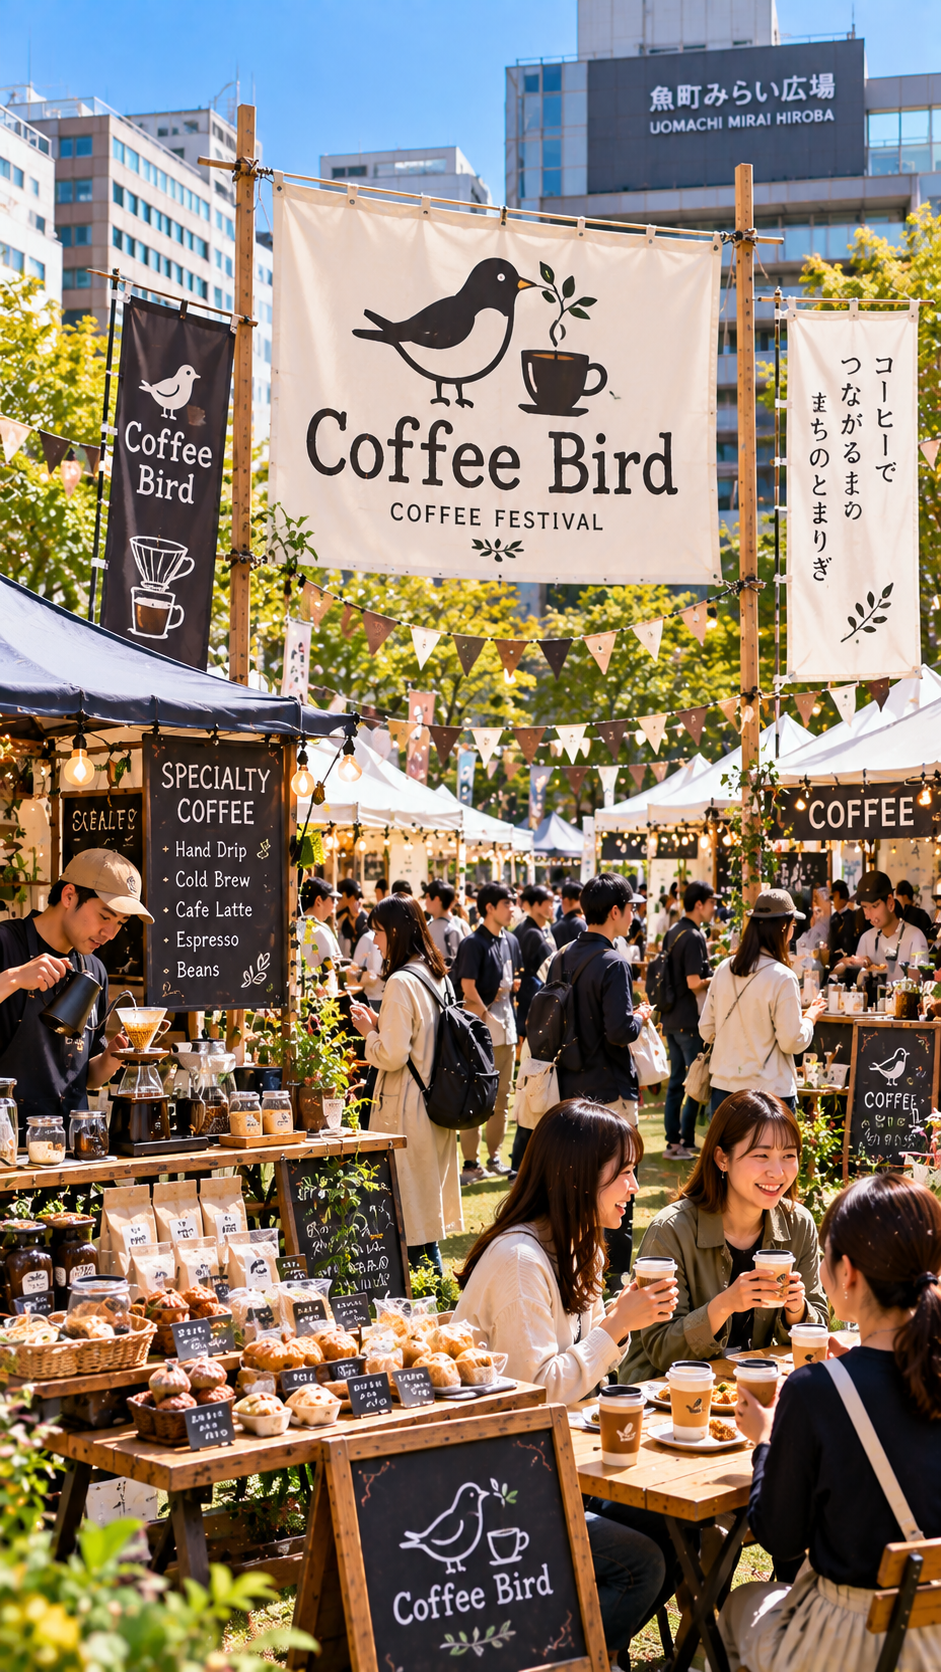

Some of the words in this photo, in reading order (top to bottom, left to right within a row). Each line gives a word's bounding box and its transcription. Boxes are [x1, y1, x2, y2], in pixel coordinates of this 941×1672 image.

[650, 72, 836, 112] 魚町みらい広場
[650, 116, 723, 135] UOMACHI
[728, 113, 771, 129] MIRAI
[776, 108, 835, 125] HIROBA
[875, 356, 897, 483] コーヒーで
[124, 420, 213, 468] Coffee
[306, 408, 521, 491] Coffee
[548, 431, 679, 496] Bird
[136, 463, 194, 505] Bird
[390, 501, 482, 527] COFFEE
[495, 509, 603, 531] FESTIVAL
[161, 761, 271, 793] SPECIALTY
[177, 798, 255, 825] COFFEE
[808, 796, 915, 830] COFFEE
[175, 840, 212, 858] Hand
[217, 840, 247, 862] Drip
[175, 870, 208, 888] Cold
[214, 870, 251, 888] Brew
[175, 900, 209, 918] Cafe
[216, 901, 253, 918] Latte
[176, 930, 240, 952] Espresso
[177, 961, 220, 978] Beans
[393, 1582, 486, 1626] Coffee
[493, 1562, 554, 1606] Bird
